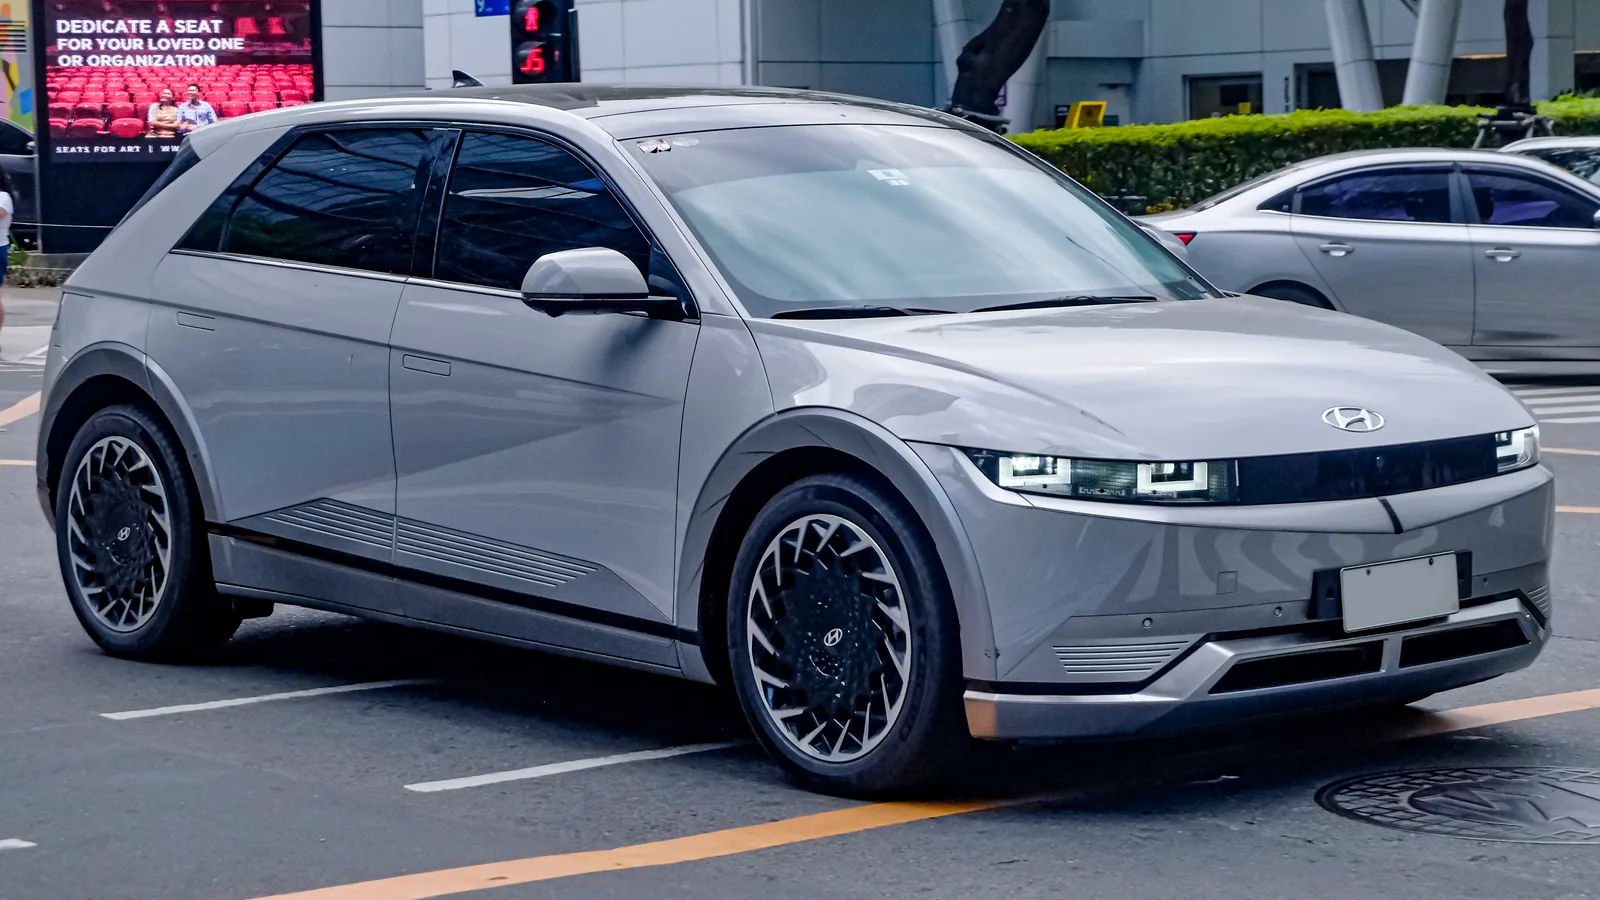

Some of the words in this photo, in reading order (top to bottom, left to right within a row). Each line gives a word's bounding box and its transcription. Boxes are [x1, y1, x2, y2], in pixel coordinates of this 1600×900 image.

[56, 19, 152, 34] DEDICATE
[156, 19, 171, 34] A
[174, 19, 224, 34] SEAT
[57, 38, 94, 51] FOR
[95, 38, 144, 51] YOUR
[147, 38, 205, 51] LOVED
[207, 37, 245, 50] ONE
[57, 54, 84, 67] OR
[86, 54, 216, 67] ORGANIZATION
[56, 146, 91, 154] SEATS
[93, 146, 116, 154] FOR
[119, 145, 141, 153] ART
